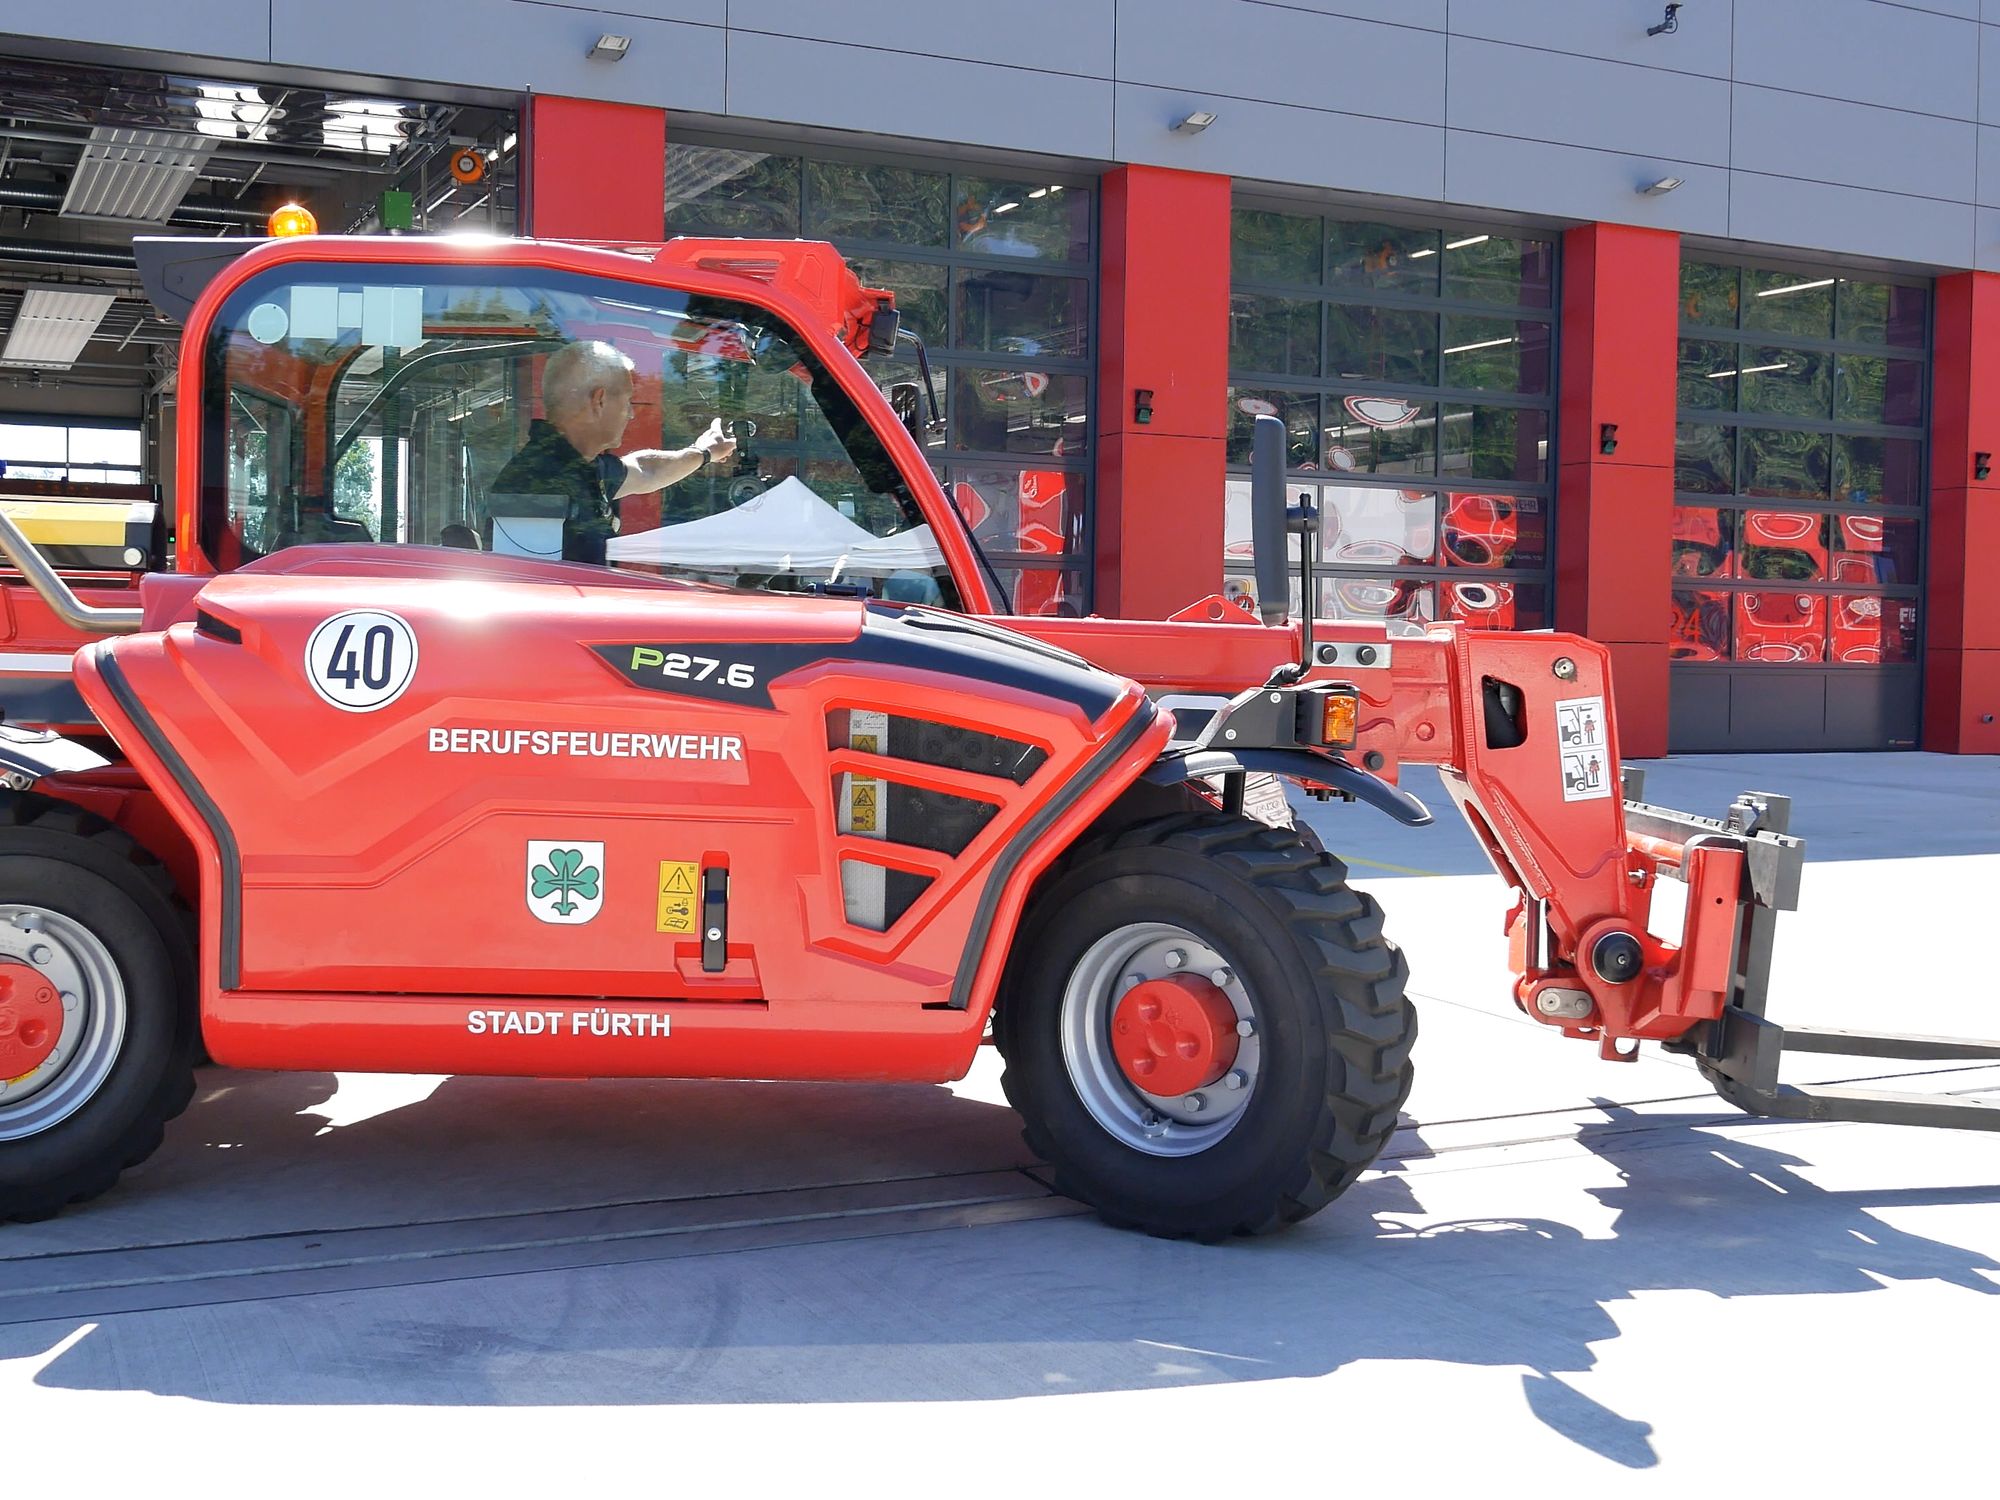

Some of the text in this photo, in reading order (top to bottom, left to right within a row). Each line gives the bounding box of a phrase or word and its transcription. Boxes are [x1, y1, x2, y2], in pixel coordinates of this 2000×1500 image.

[326, 624, 393, 690] 40
[630, 646, 756, 689] P27.6
[429, 728, 742, 761] BERUFSFEUERWEHR
[467, 1007, 671, 1037] STADT FÜRTH
